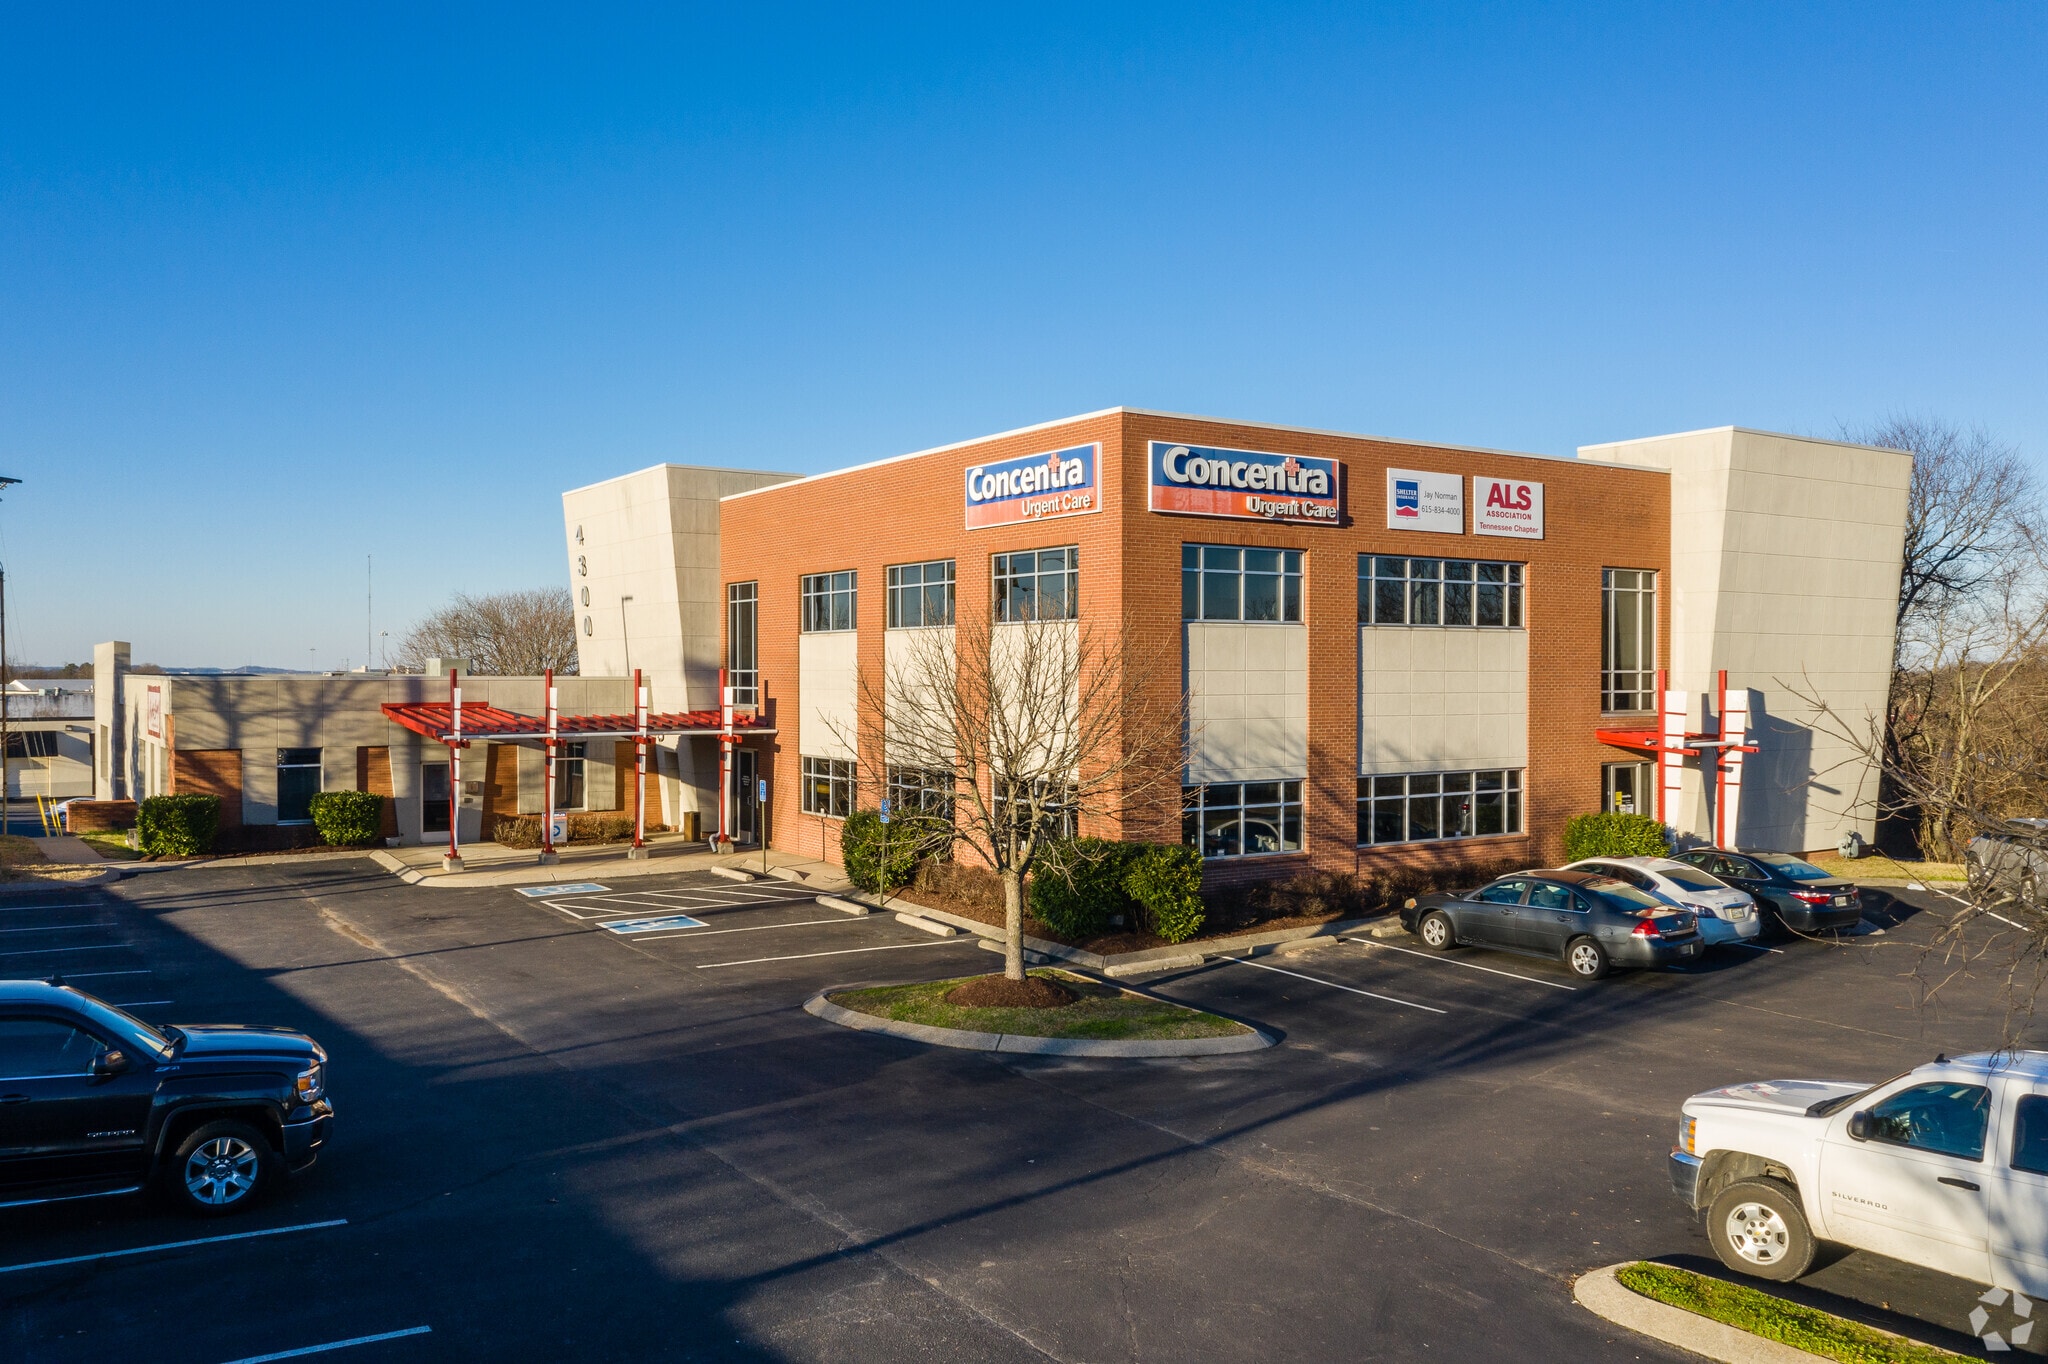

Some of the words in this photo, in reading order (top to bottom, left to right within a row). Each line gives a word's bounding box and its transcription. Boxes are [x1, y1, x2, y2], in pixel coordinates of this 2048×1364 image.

[968, 453, 1083, 501] Concentra
[1163, 446, 1328, 495] Concentra
[1396, 488, 1417, 496] SHELTER
[1424, 490, 1434, 500] Jay
[1434, 491, 1458, 501] Norman
[1486, 482, 1532, 511] ALS
[1022, 497, 1060, 518] Urgent
[1062, 493, 1092, 511] Care
[1246, 496, 1300, 518] Urgent
[1301, 501, 1337, 518] Care
[1421, 504, 1460, 515] 615-834-4000
[1486, 510, 1532, 521] ASSOCIATION
[1480, 521, 1513, 532] Tennessee
[1513, 524, 1539, 534] Chapter
[1832, 1191, 1887, 1210] SILVERADO
